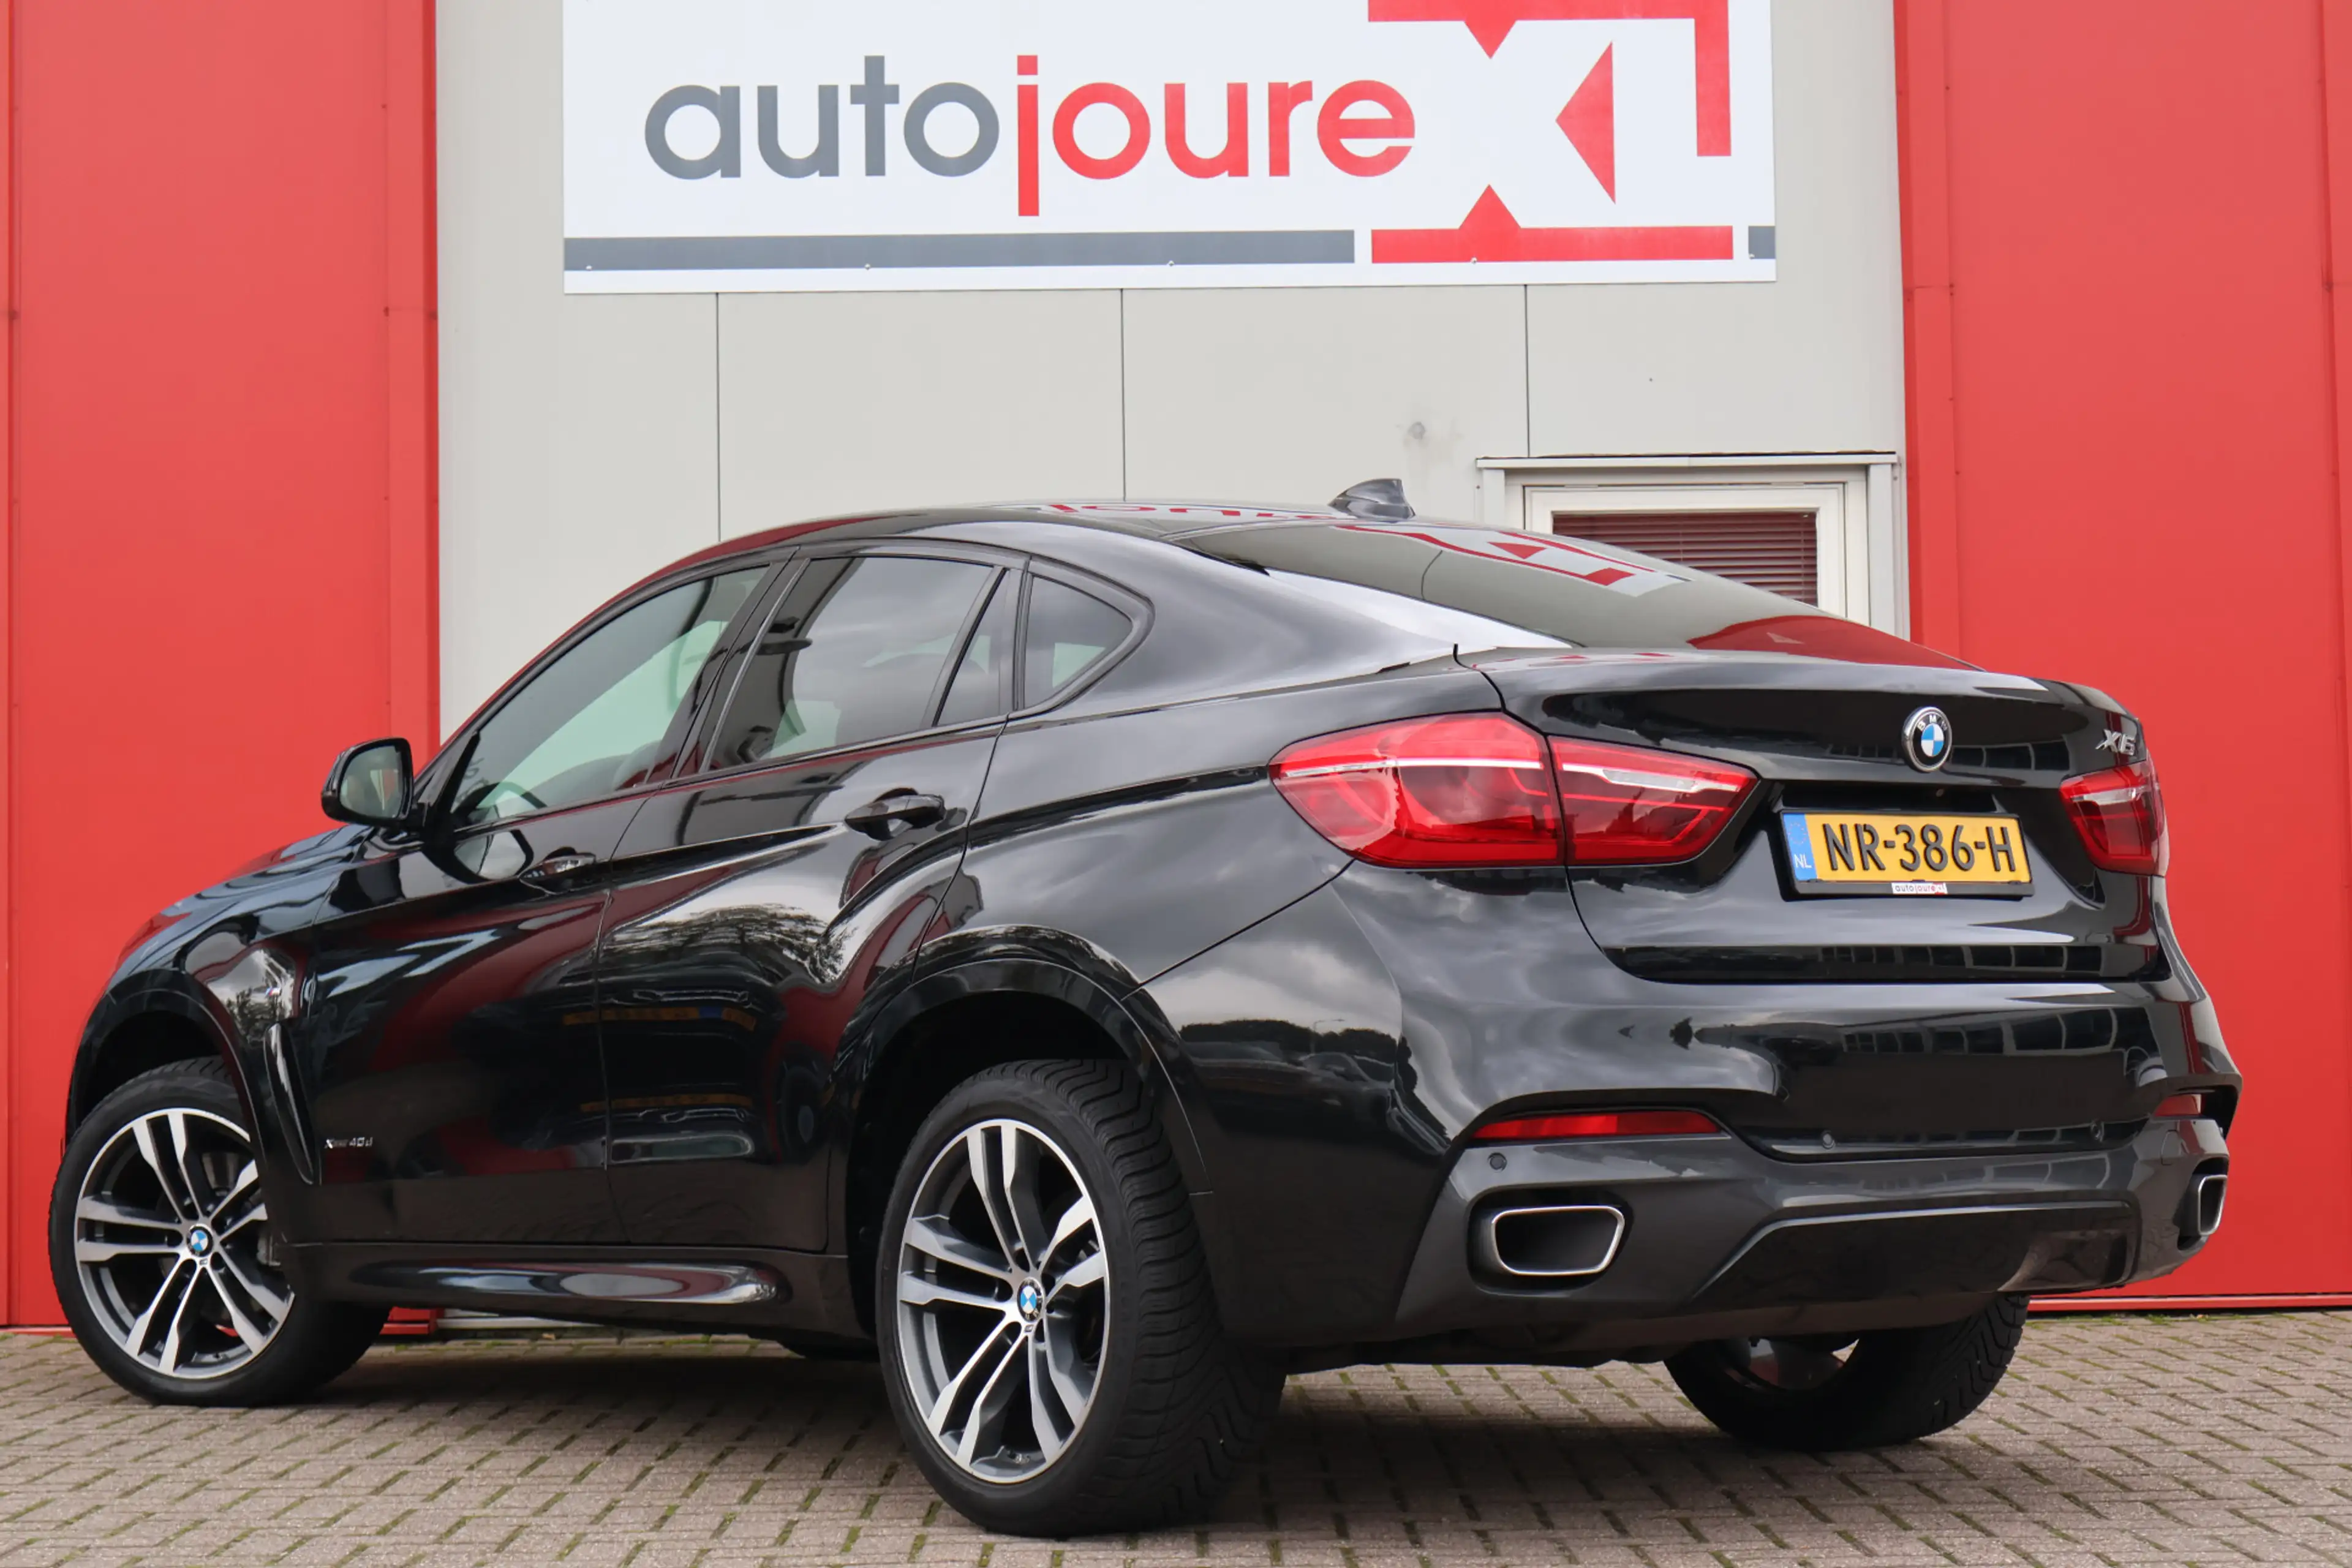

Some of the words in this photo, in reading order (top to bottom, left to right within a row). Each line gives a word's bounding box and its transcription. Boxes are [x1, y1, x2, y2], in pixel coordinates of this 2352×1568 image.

[2095, 729, 2136, 756] X6
[1822, 823, 2016, 872] NR-386-H
[1794, 854, 1812, 869] NL
